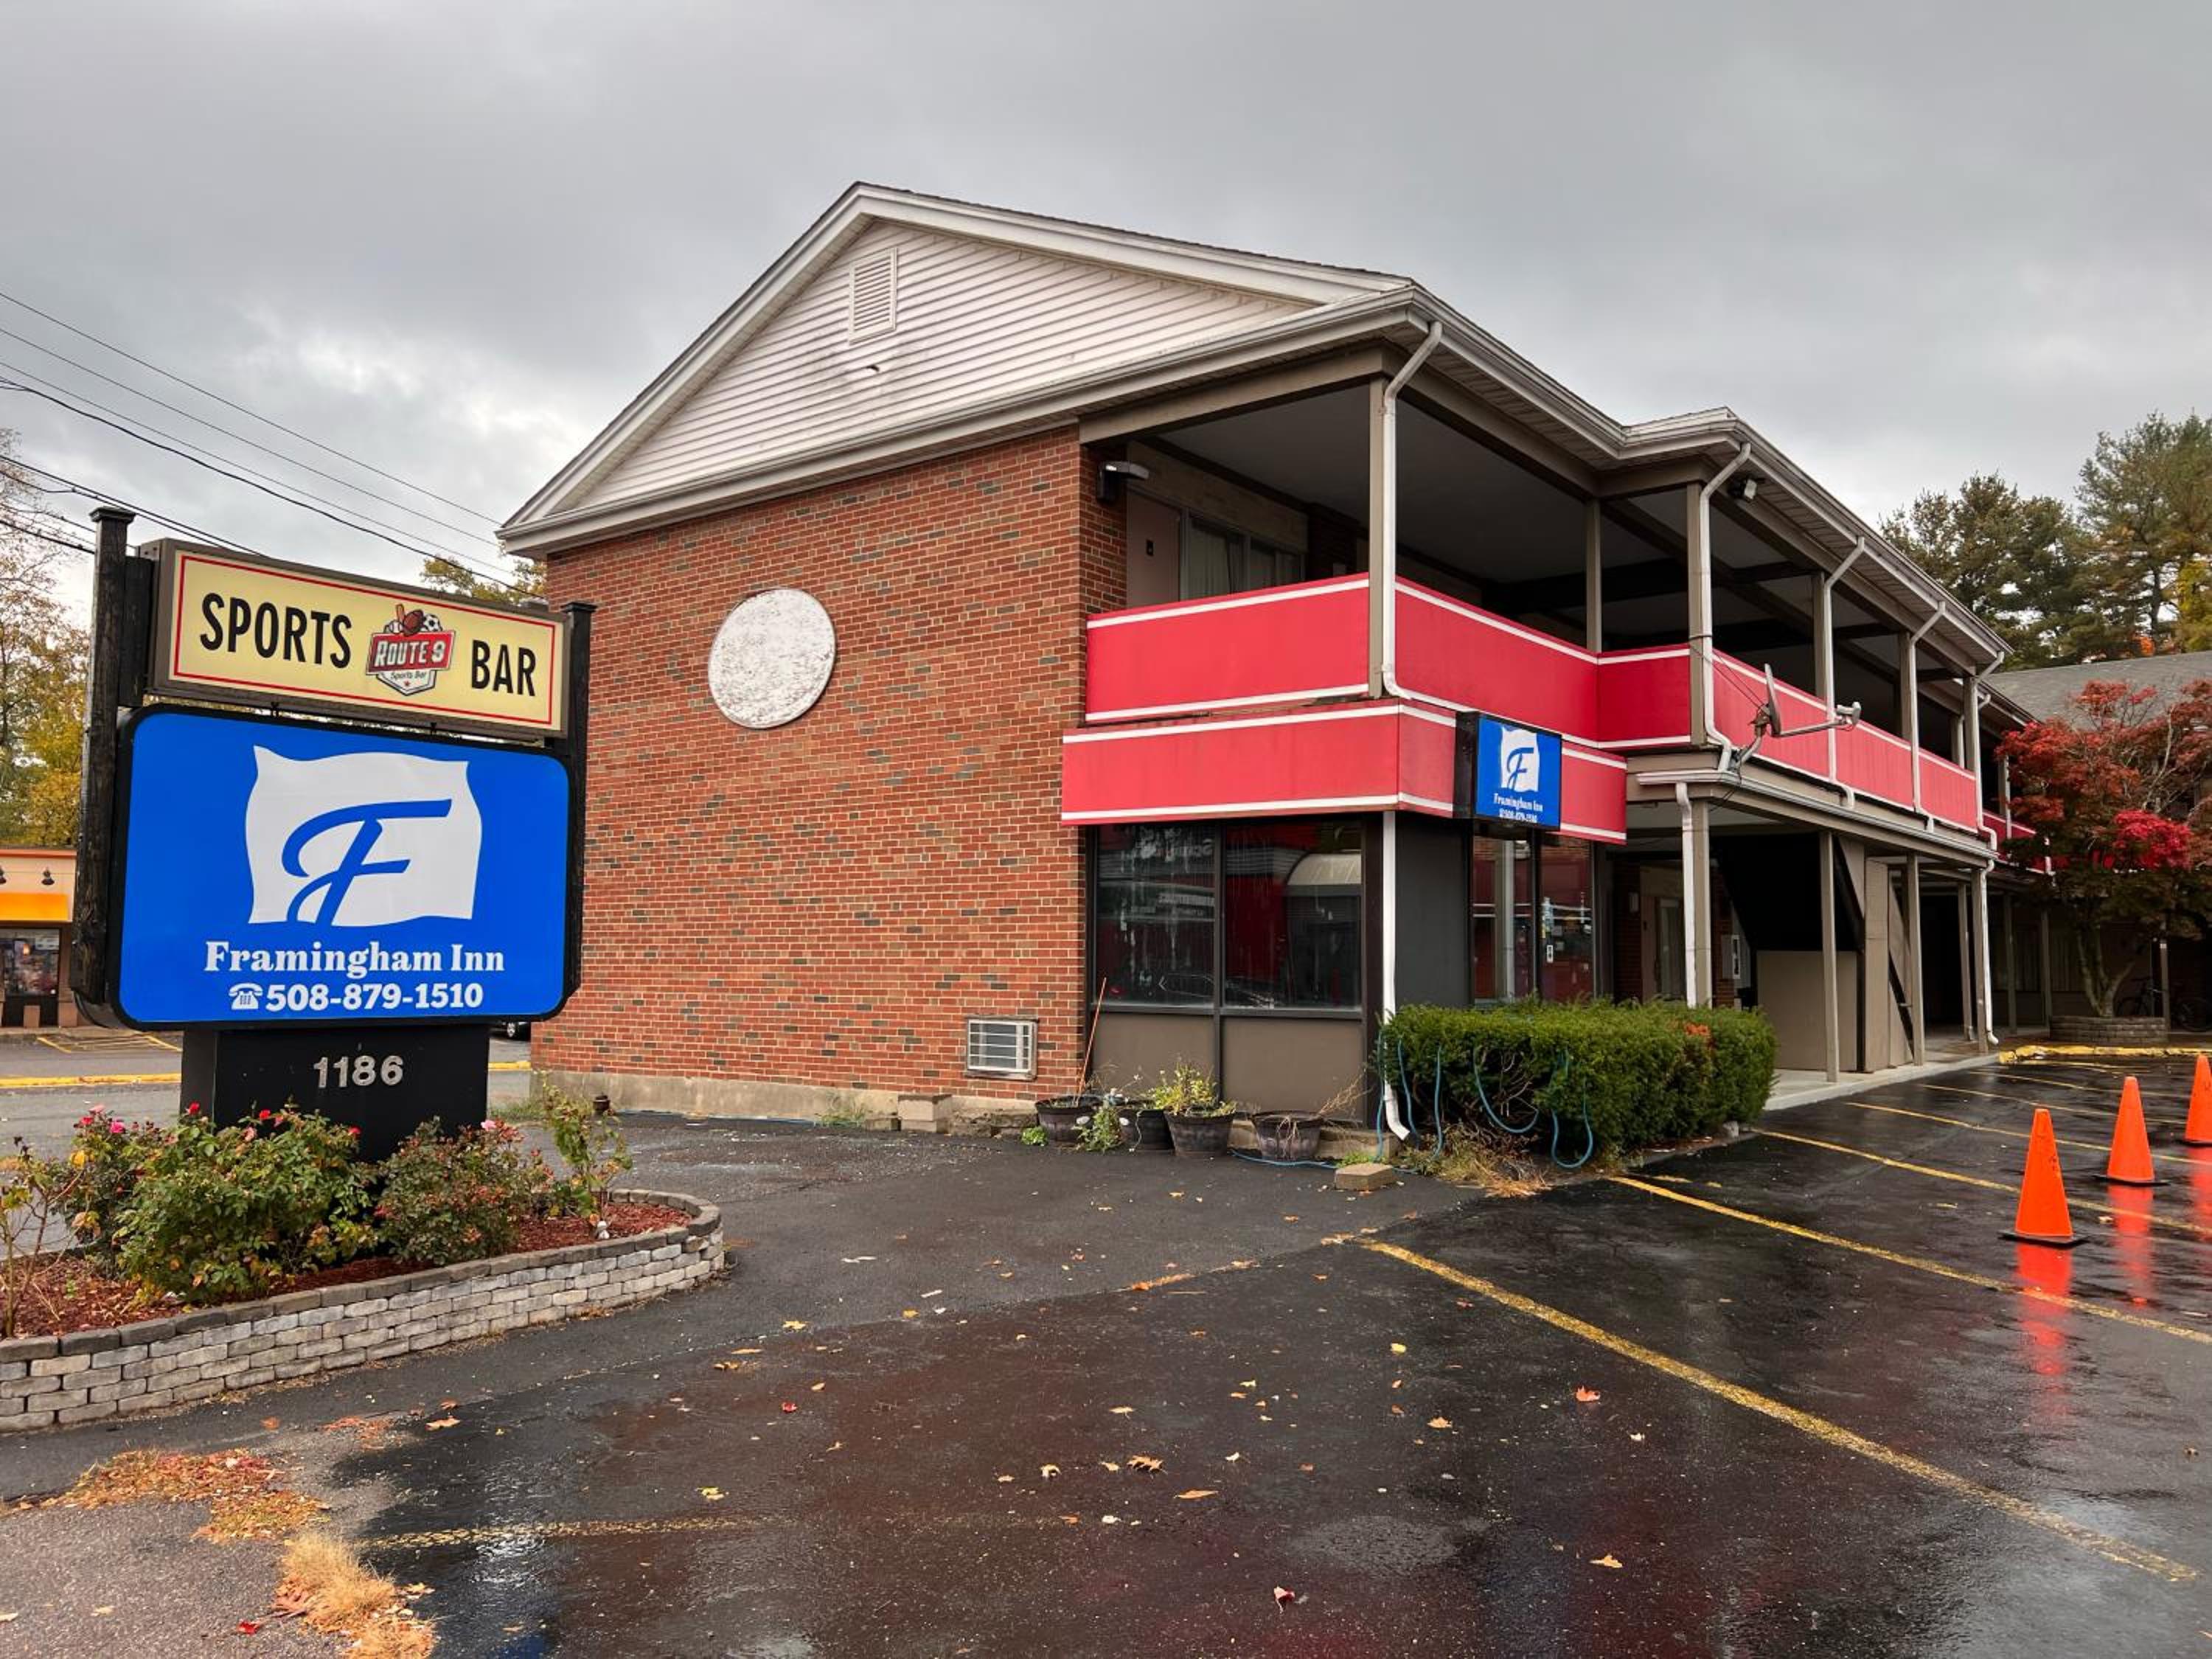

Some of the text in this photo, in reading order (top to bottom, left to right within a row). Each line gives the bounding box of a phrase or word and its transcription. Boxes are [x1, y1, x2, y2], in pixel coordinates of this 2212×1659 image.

[199, 592, 536, 696] SPORTS BAR
[374, 640, 446, 667] ROUTE 9
[390, 670, 427, 680] Sports Bar
[204, 941, 505, 978] Framingham Inn
[265, 982, 484, 1012] 508-879-1510
[313, 1055, 405, 1089] 1186
